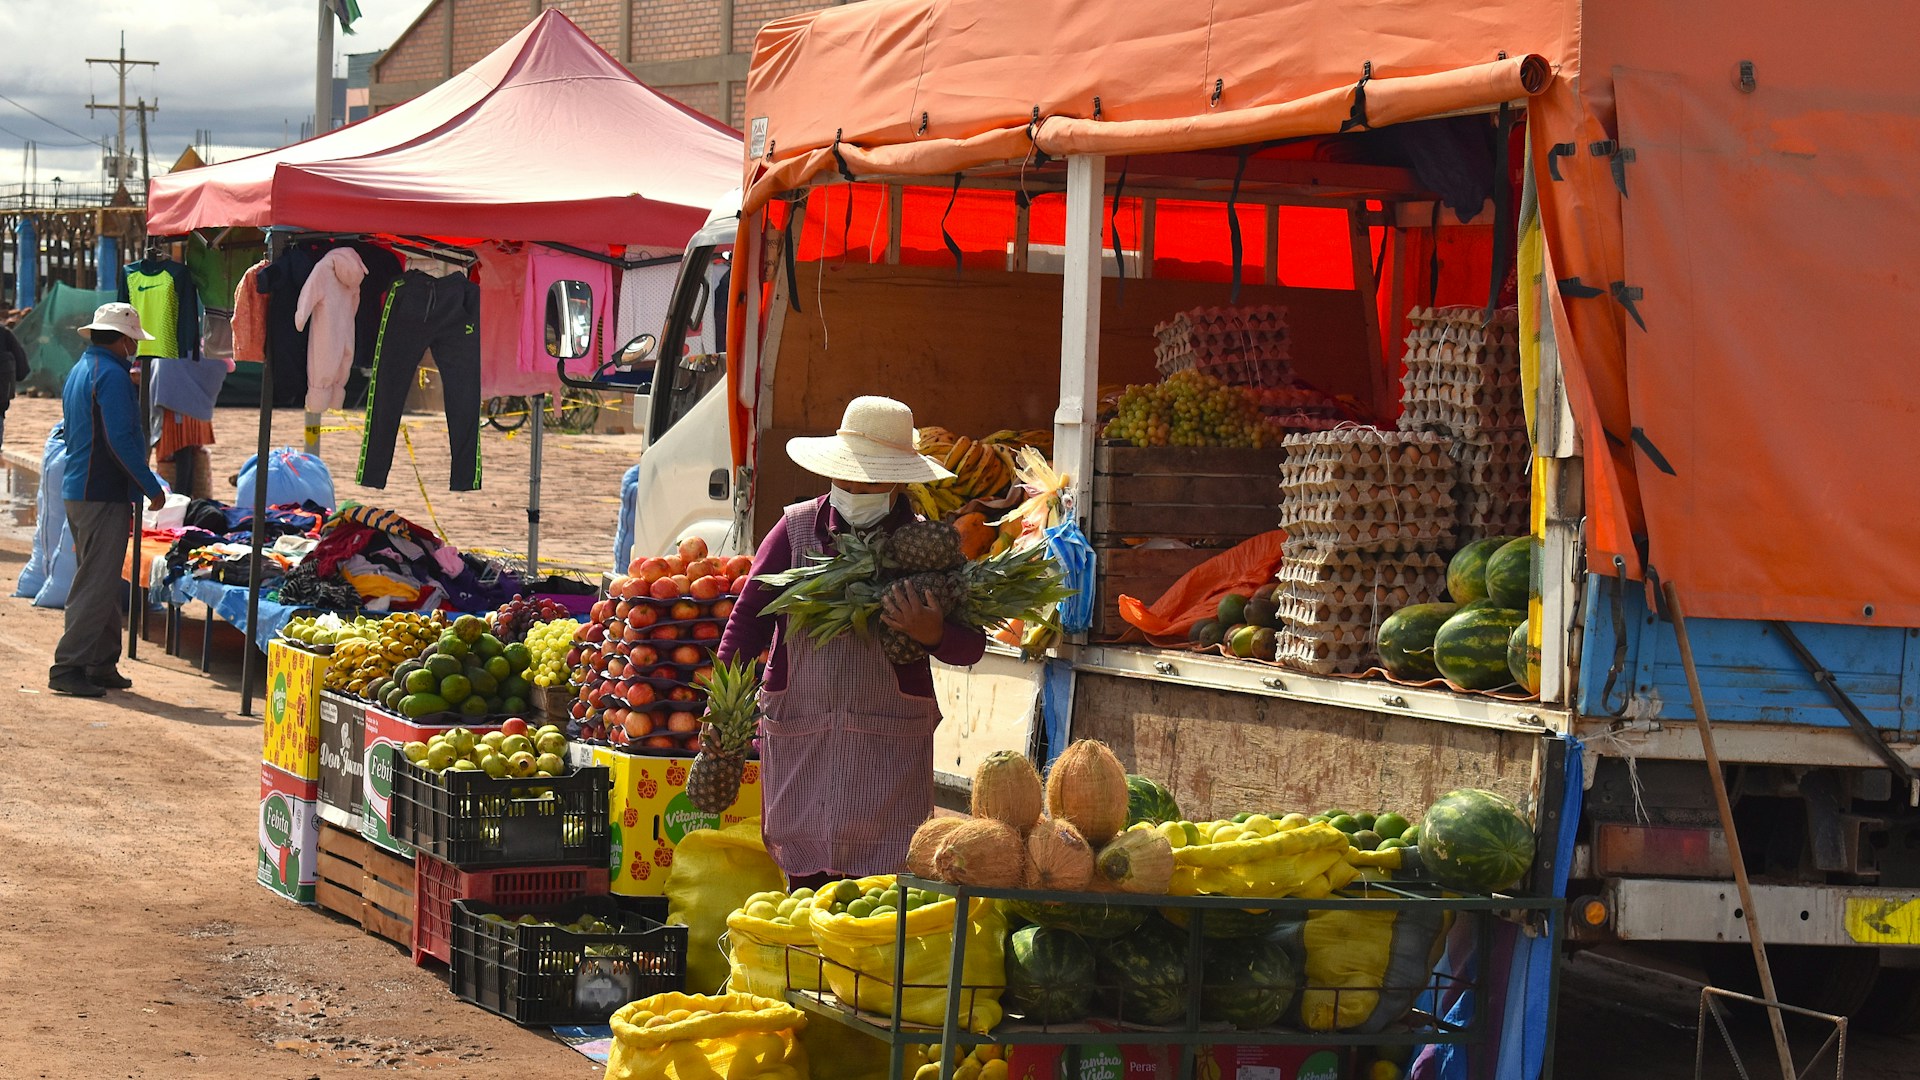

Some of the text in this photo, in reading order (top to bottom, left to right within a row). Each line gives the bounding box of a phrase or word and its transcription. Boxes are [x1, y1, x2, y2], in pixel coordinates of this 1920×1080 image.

[320, 742, 363, 776] Don Juan
[371, 755, 392, 782] Febit
[266, 806, 289, 834] Febita
[666, 810, 718, 828] Vitamina
[1129, 1061, 1157, 1072] Peras
